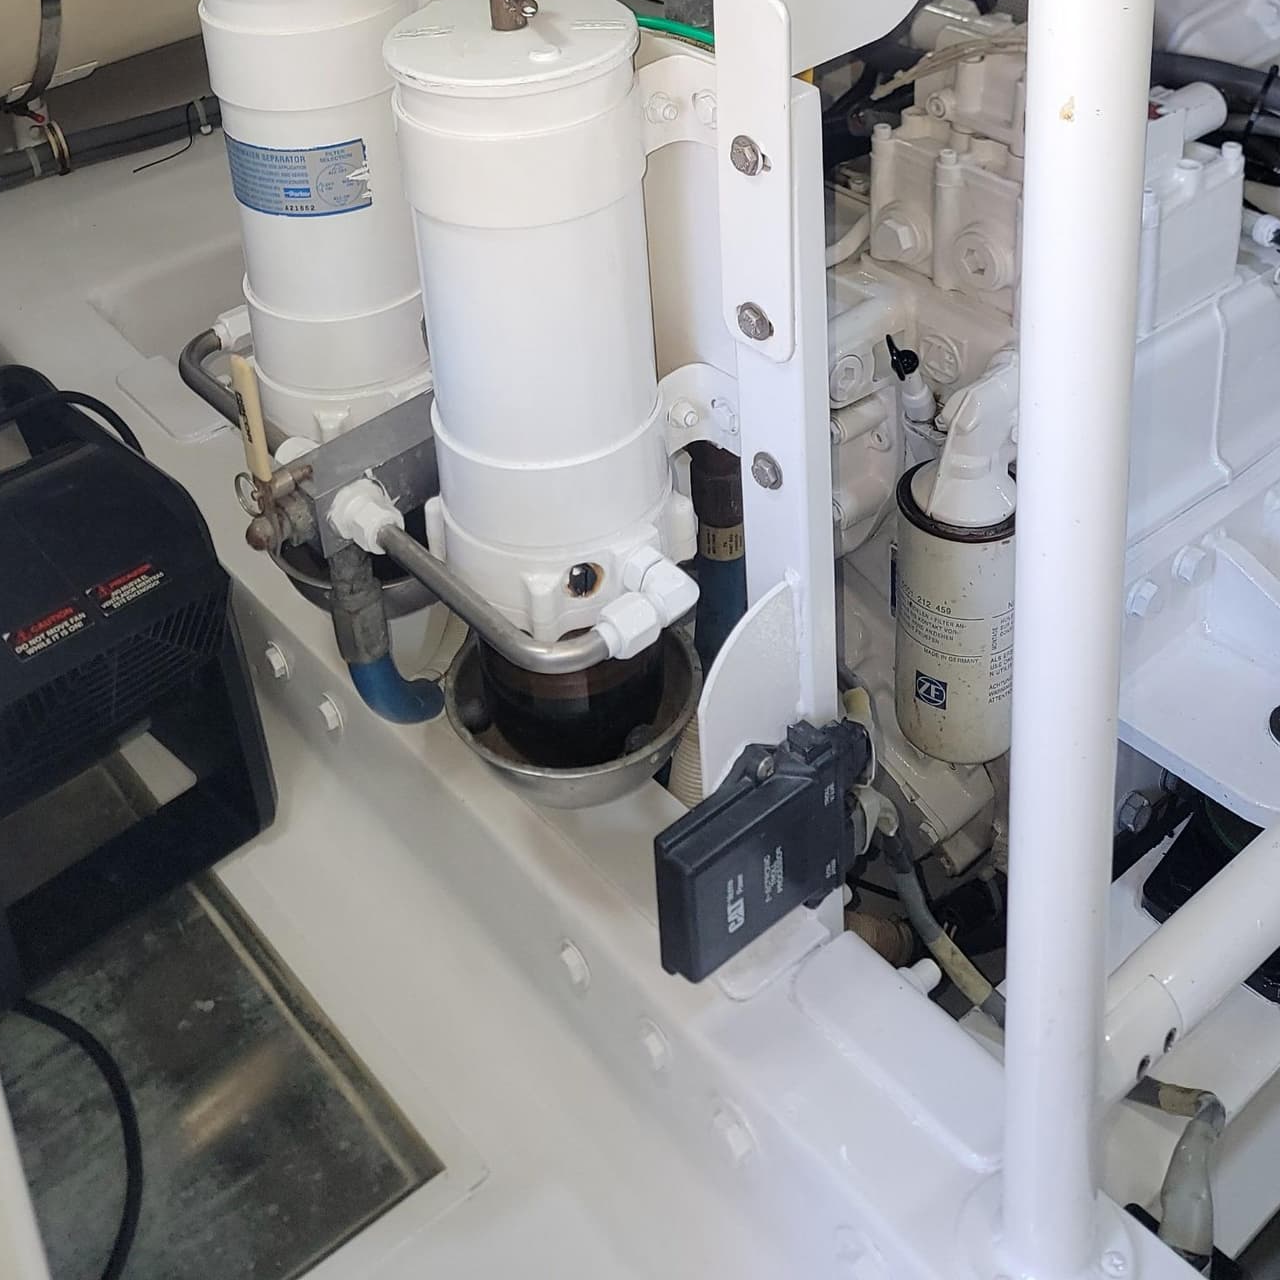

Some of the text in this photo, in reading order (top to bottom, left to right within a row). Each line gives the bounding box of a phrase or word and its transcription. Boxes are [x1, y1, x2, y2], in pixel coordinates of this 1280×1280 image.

[261, 152, 306, 165] SEPARATOR
[917, 595, 932, 609] 212
[15, 612, 87, 655] DO NOT MOVE FAN
[26, 637, 53, 656] WHILE
[52, 633, 60, 642] IT
[60, 628, 69, 637] IS
[923, 648, 939, 658] MADE
[948, 656, 979, 664] GERMANY
[727, 897, 745, 933] CAT
